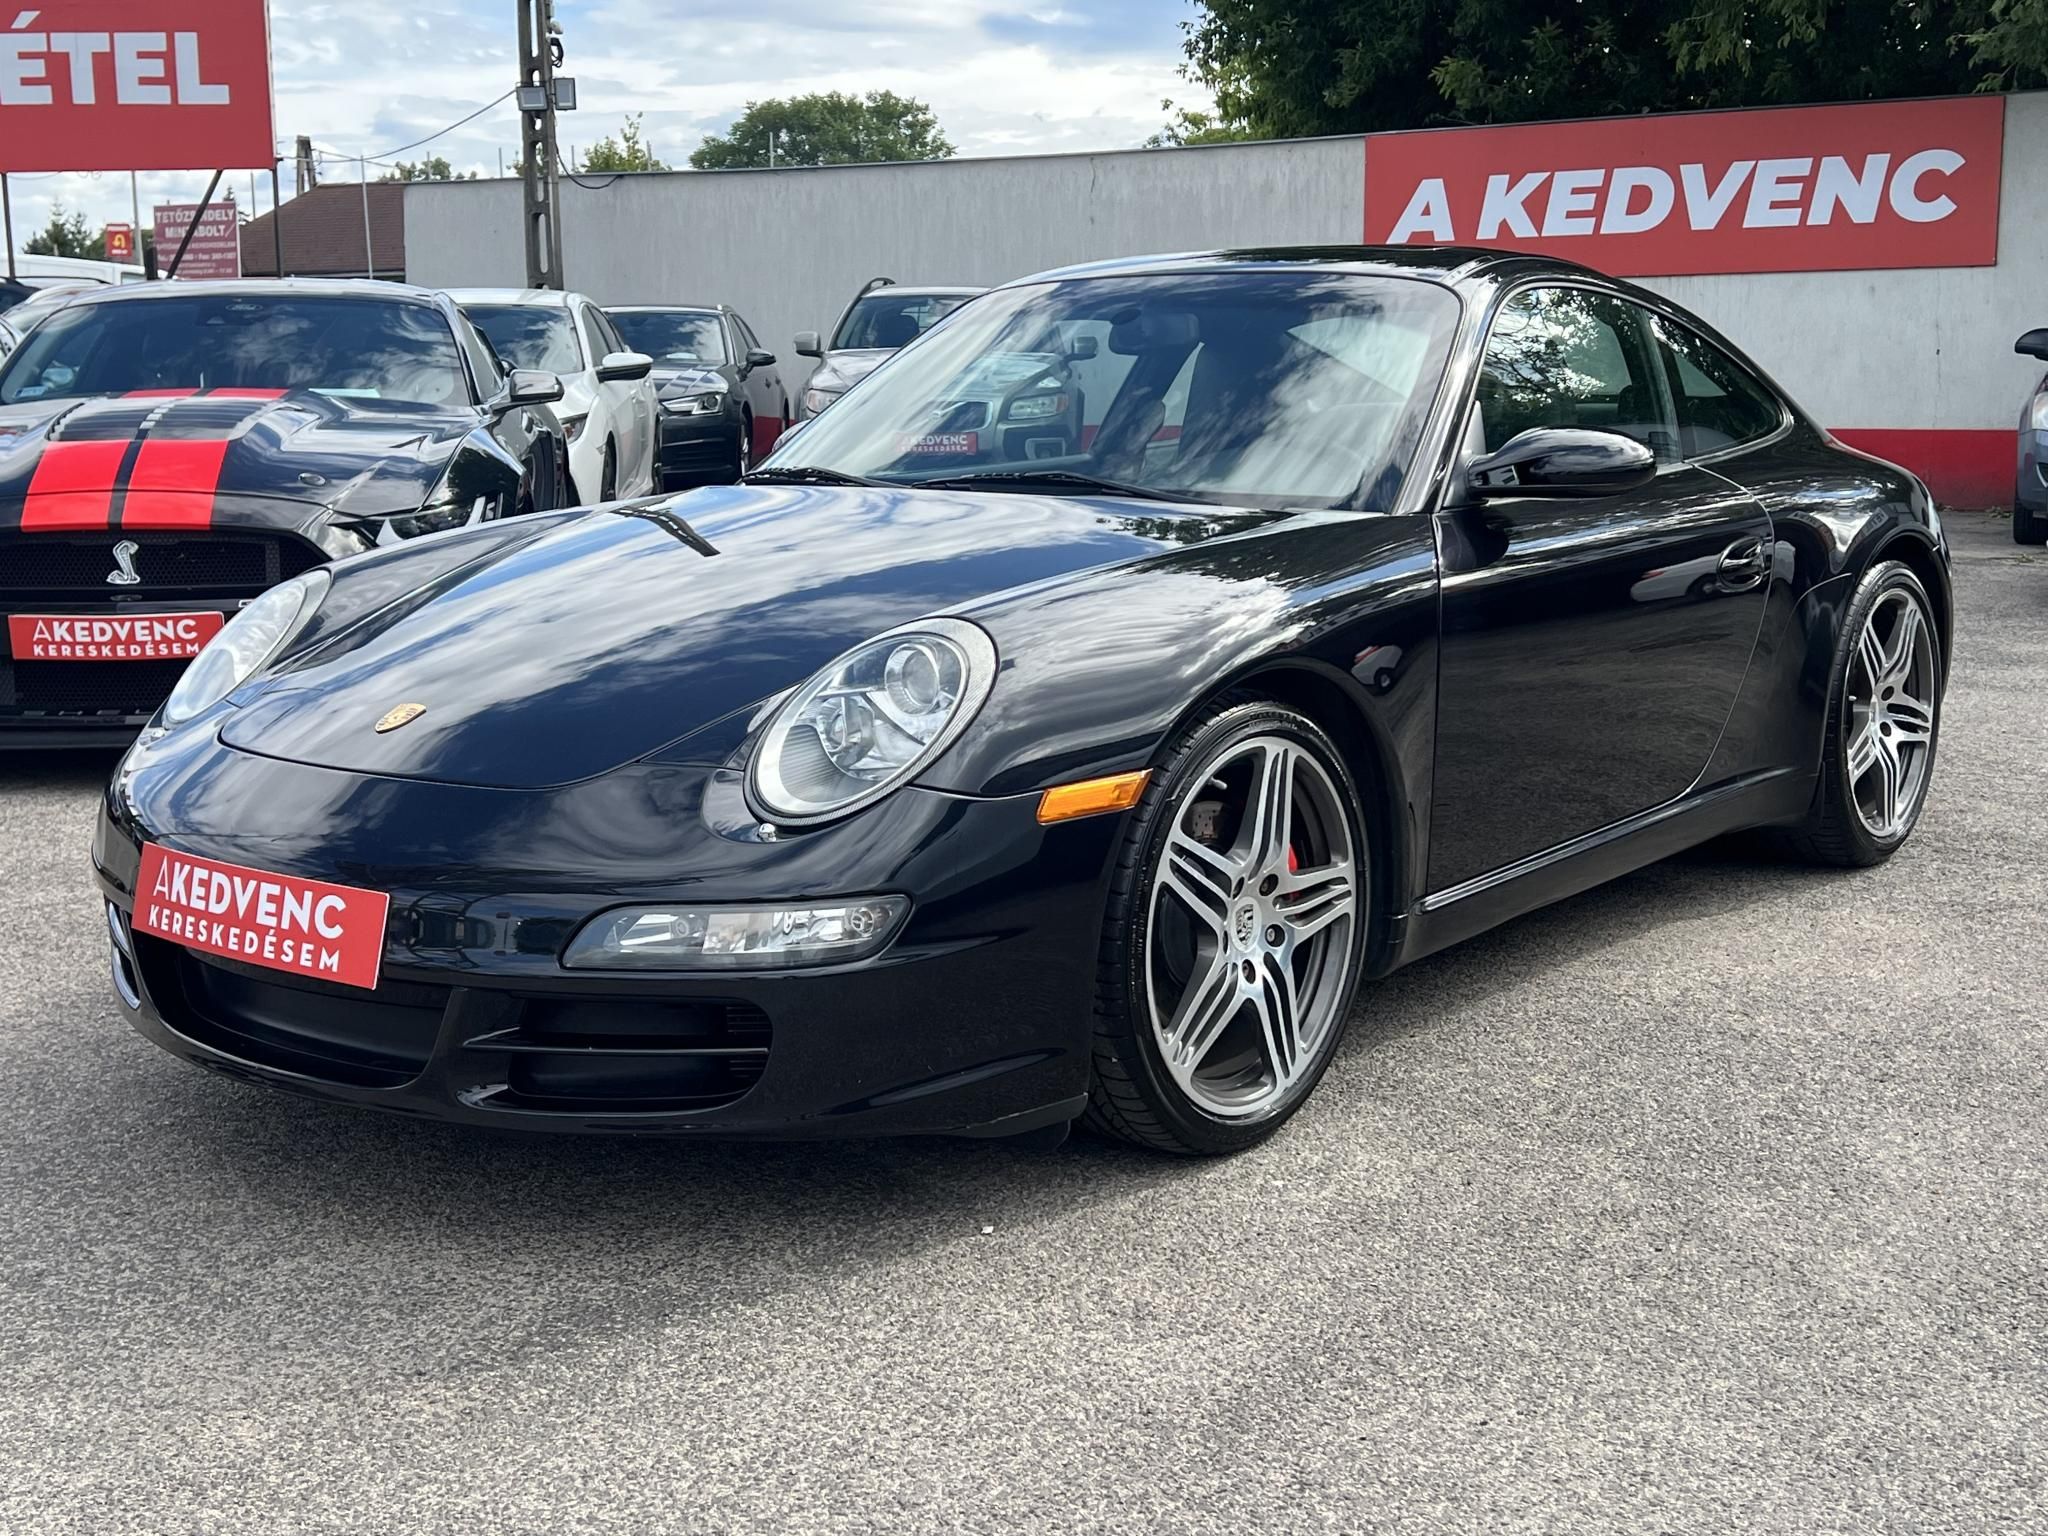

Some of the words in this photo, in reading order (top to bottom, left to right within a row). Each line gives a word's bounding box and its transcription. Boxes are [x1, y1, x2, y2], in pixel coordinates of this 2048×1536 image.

[0, 10, 231, 106] ÉTEL
[1386, 178, 1456, 246] A
[1475, 149, 1966, 241] KEDVENC
[33, 641, 200, 657] KERESKEDÉSEM
[148, 904, 340, 973] KERESKEDÉSEM
